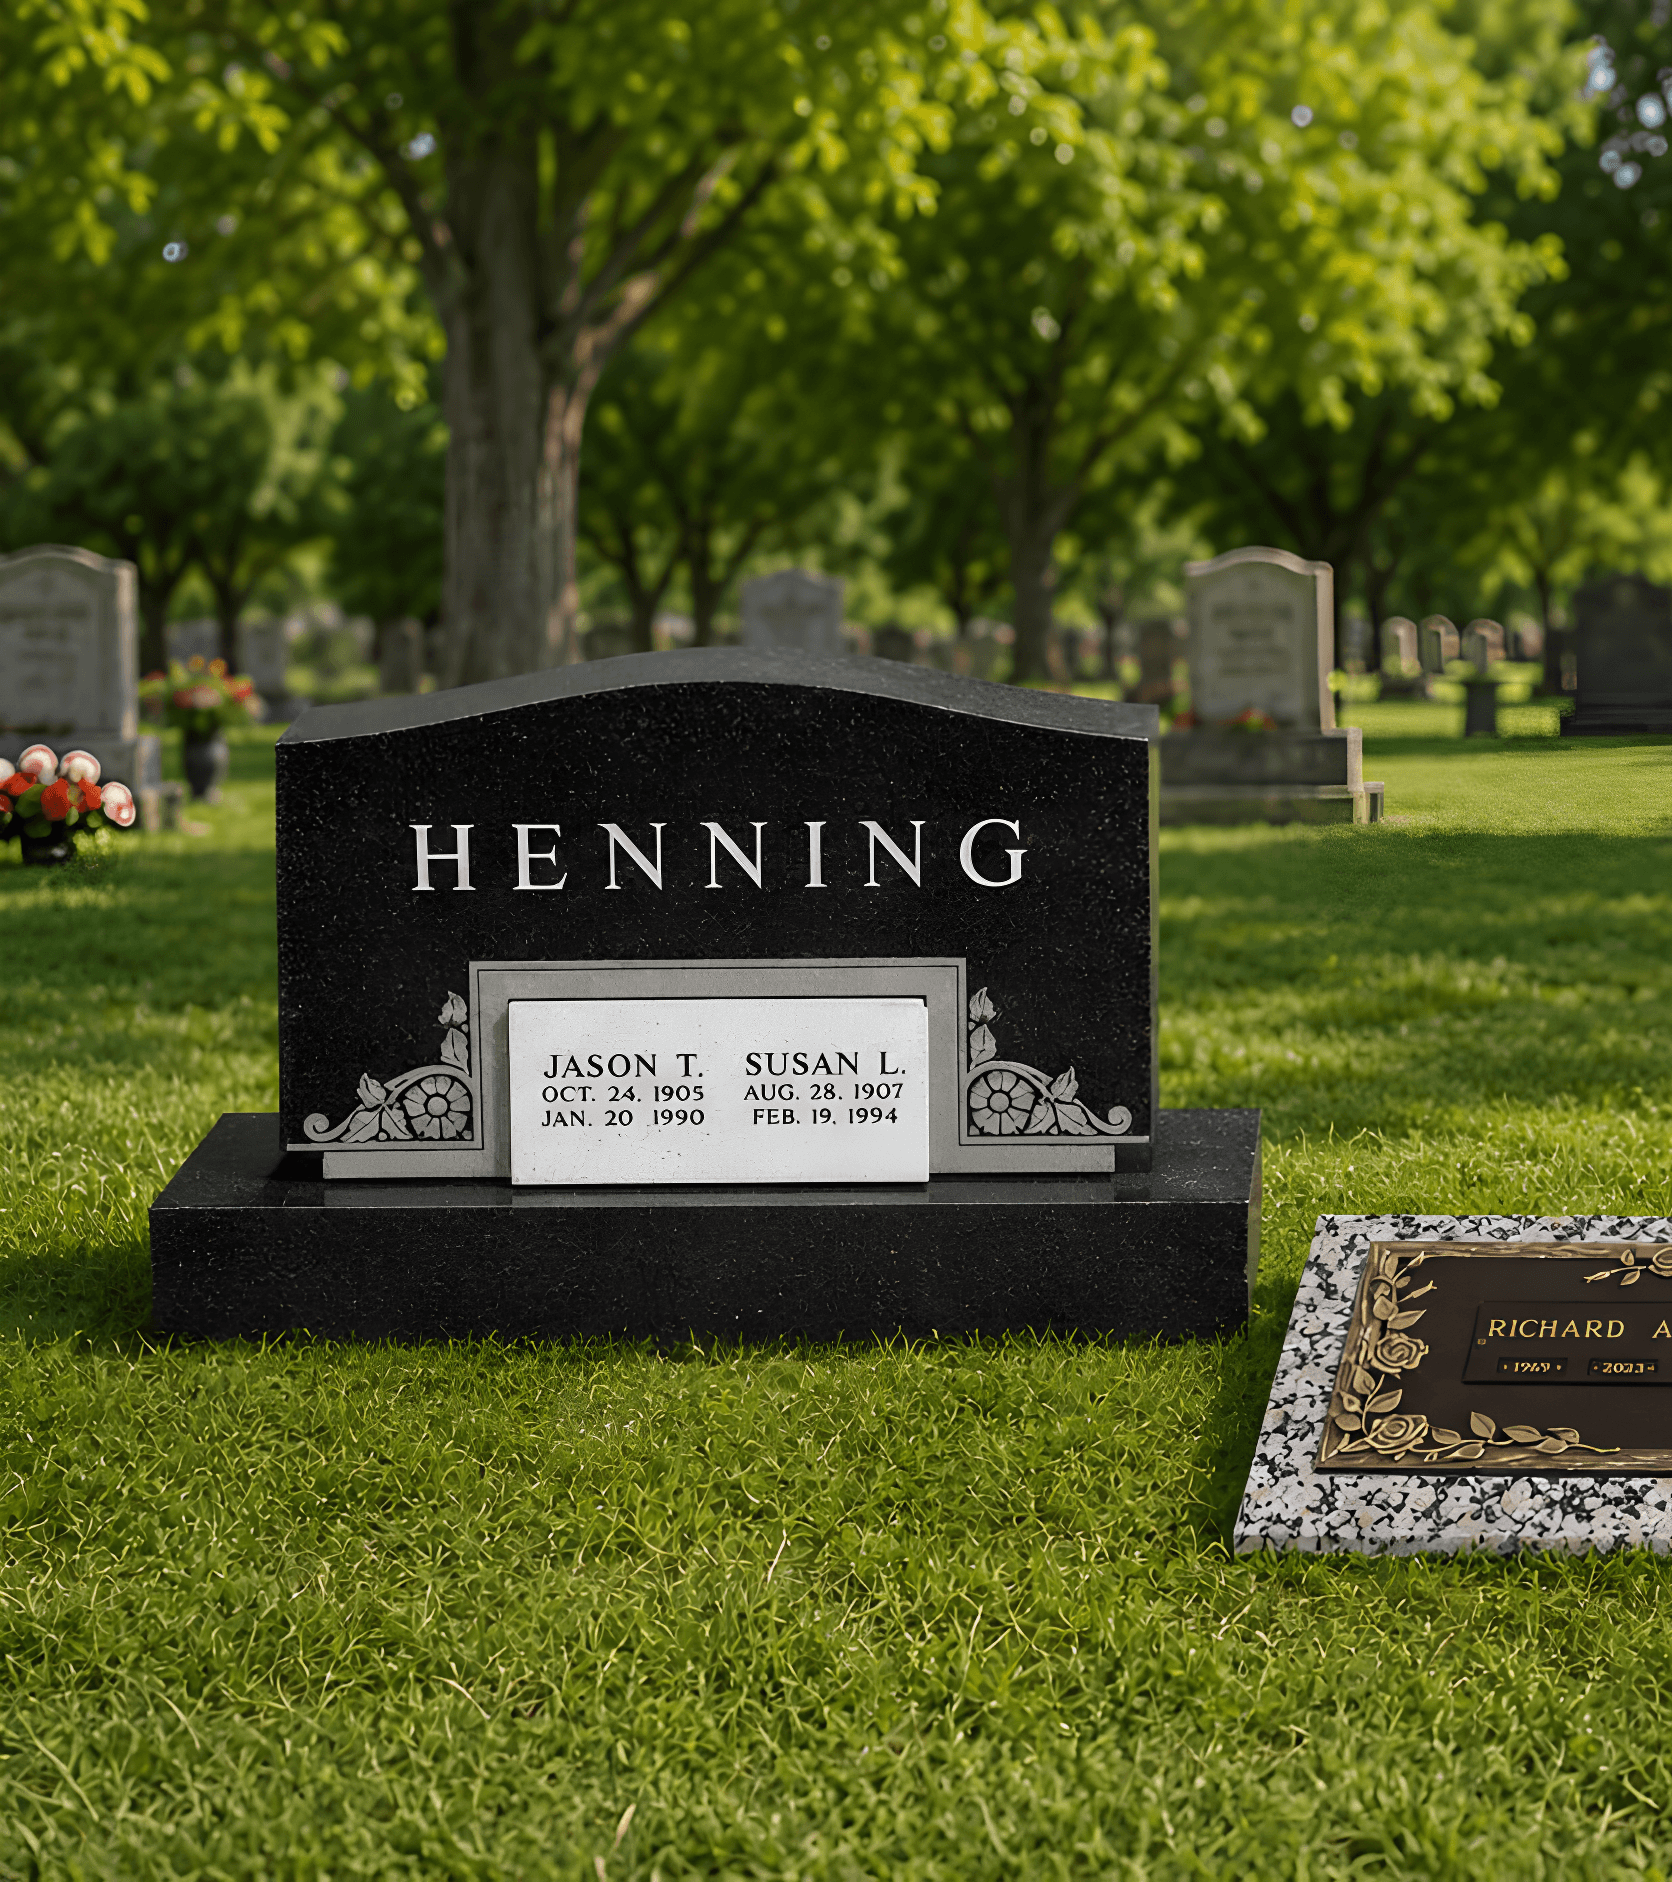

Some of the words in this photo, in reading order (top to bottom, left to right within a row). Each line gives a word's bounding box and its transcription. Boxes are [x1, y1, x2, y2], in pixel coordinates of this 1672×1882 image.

[408, 818, 1029, 892] HENNING
[543, 1053, 658, 1079] JASON
[675, 1053, 704, 1078] T.
[744, 1051, 860, 1077] SUSAN
[879, 1051, 907, 1076] L.
[541, 1085, 596, 1103] OCT.
[606, 1085, 642, 1103] 24.
[653, 1084, 705, 1102] 1905
[743, 1083, 800, 1101] AUG.
[809, 1083, 843, 1101] 28.
[854, 1083, 905, 1101] 1907
[541, 1109, 593, 1128] JAN.
[604, 1109, 634, 1127] 20
[653, 1108, 706, 1126] 1990
[752, 1108, 801, 1125] FEB.
[811, 1108, 837, 1125] 19.
[848, 1107, 899, 1125] 1994
[1488, 1319, 1626, 1339] RICHARD
